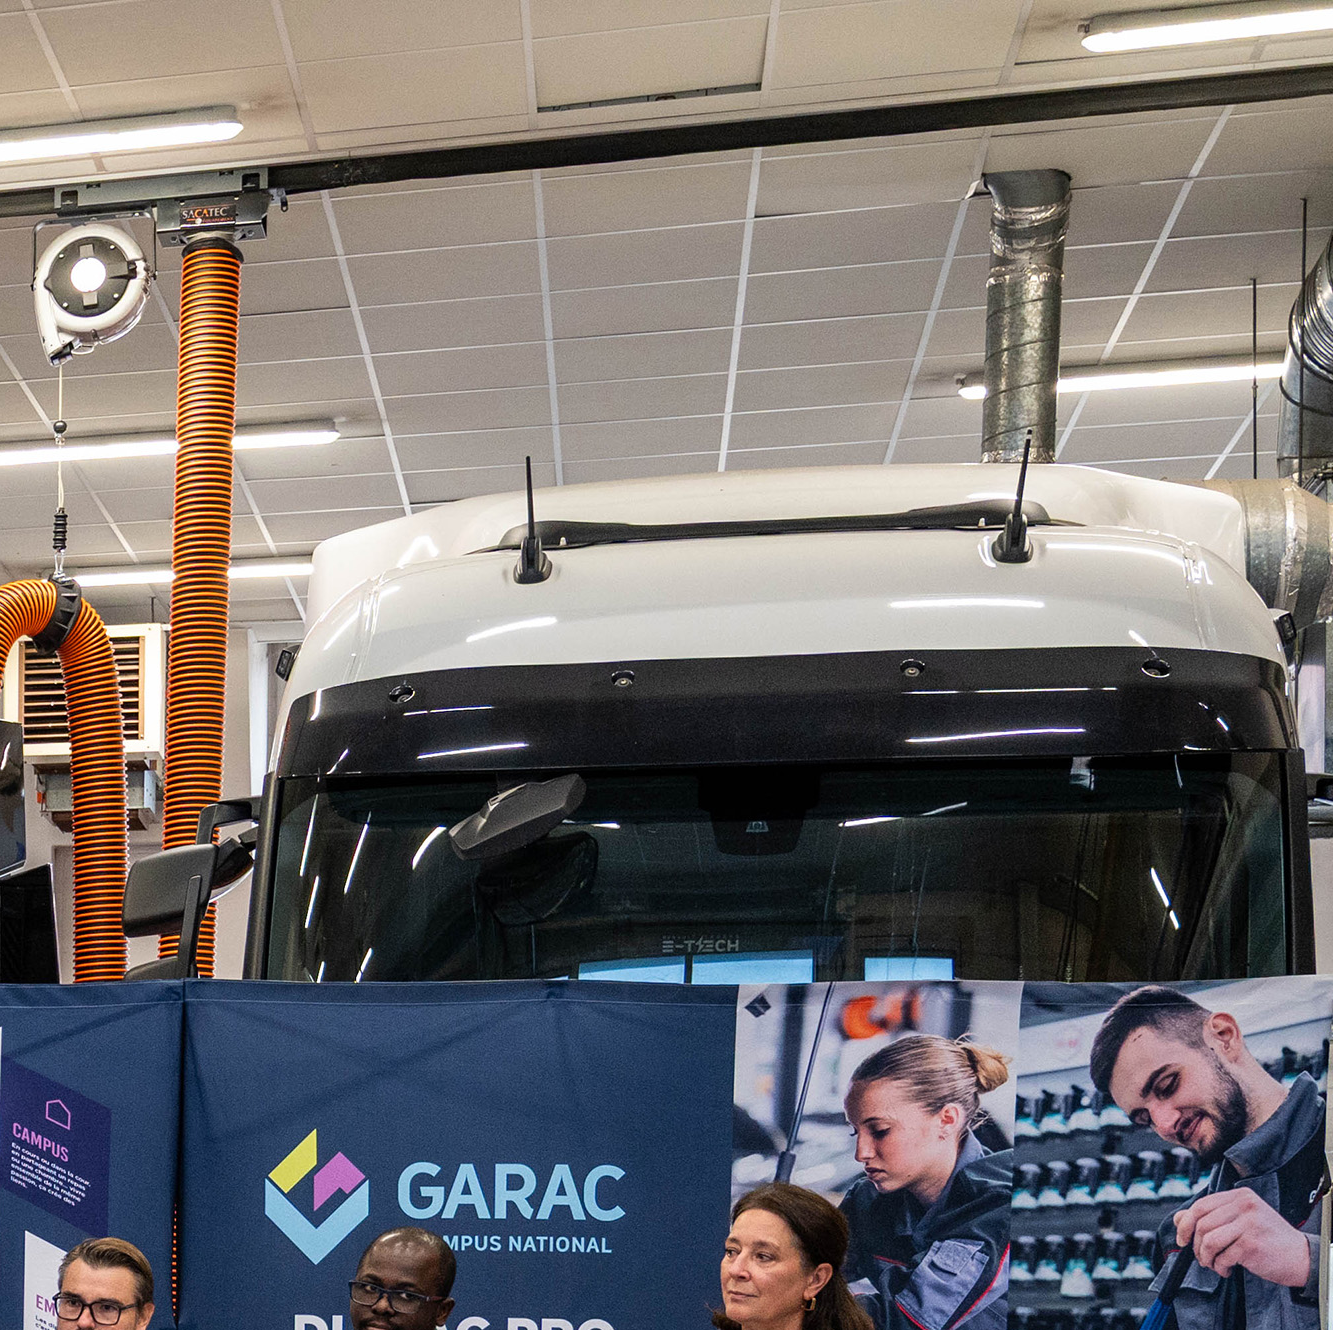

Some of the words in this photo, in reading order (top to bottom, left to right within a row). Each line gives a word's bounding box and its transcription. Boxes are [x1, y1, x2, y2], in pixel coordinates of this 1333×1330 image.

[182, 207, 227, 219] SACATEC
[13, 1122, 69, 1162] CAMPUS
[21, 1148, 40, 1160] cours
[51, 1163, 67, 1174] dans
[398, 1162, 626, 1221] GARAC
[442, 1235, 502, 1251] MPUS
[508, 1236, 612, 1254] NATIONAL
